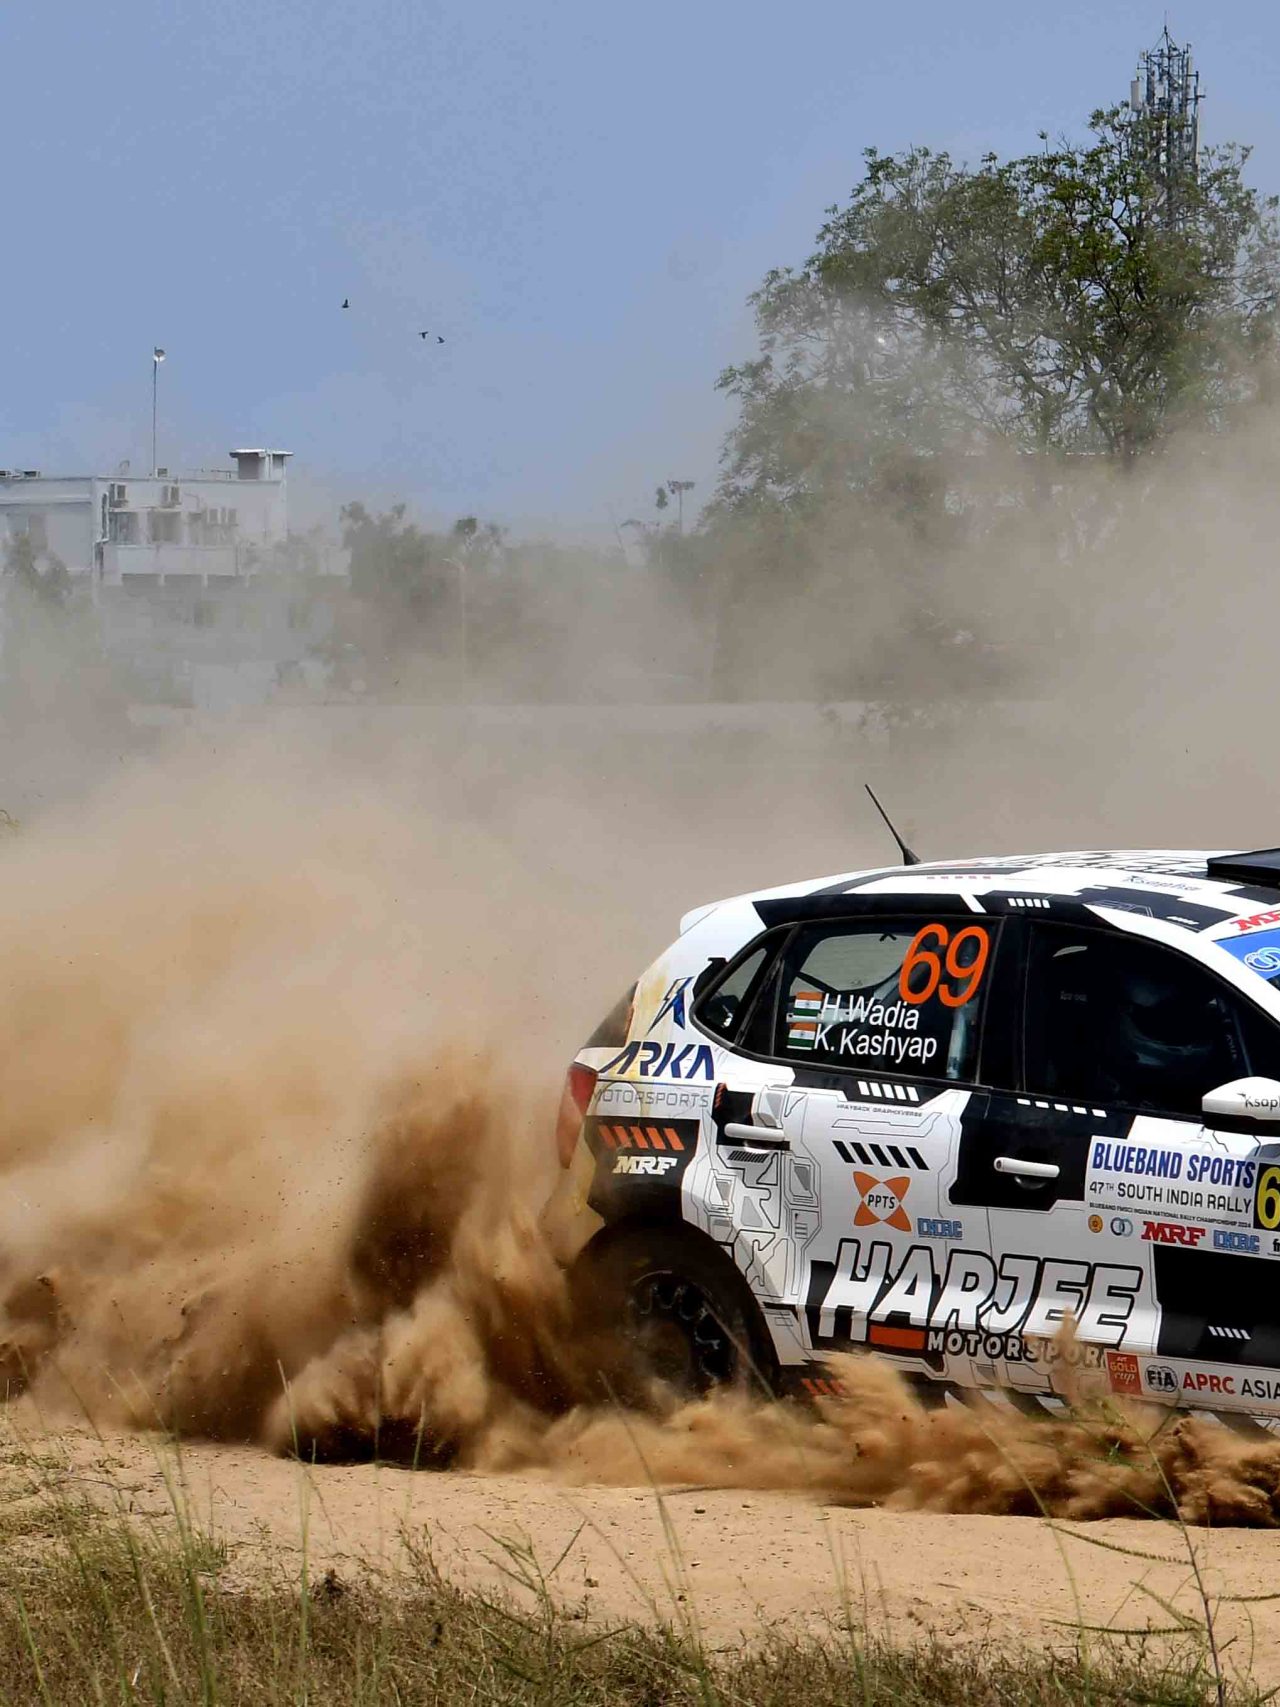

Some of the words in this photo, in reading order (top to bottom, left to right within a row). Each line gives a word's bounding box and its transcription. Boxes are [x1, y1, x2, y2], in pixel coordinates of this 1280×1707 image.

[899, 923, 990, 1008] 69
[597, 1040, 715, 1081] ARKA
[593, 1088, 710, 1108] MOTORSPORTS
[611, 1155, 679, 1175] MRF
[1092, 1142, 1183, 1180] BLUEBAND
[1186, 1153, 1257, 1189] SPORTS
[867, 1193, 896, 1210] PPTS
[1117, 1182, 1163, 1204] SOUTH
[1166, 1189, 1203, 1208] INDIA
[1207, 1194, 1252, 1214] RALLY
[1141, 1219, 1206, 1247] MRF
[817, 1237, 1144, 1346] HARJEE
[926, 1330, 1107, 1369] MOTORSPOR
[1109, 1360, 1138, 1373] GOLD
[1182, 1371, 1237, 1396] APRC
